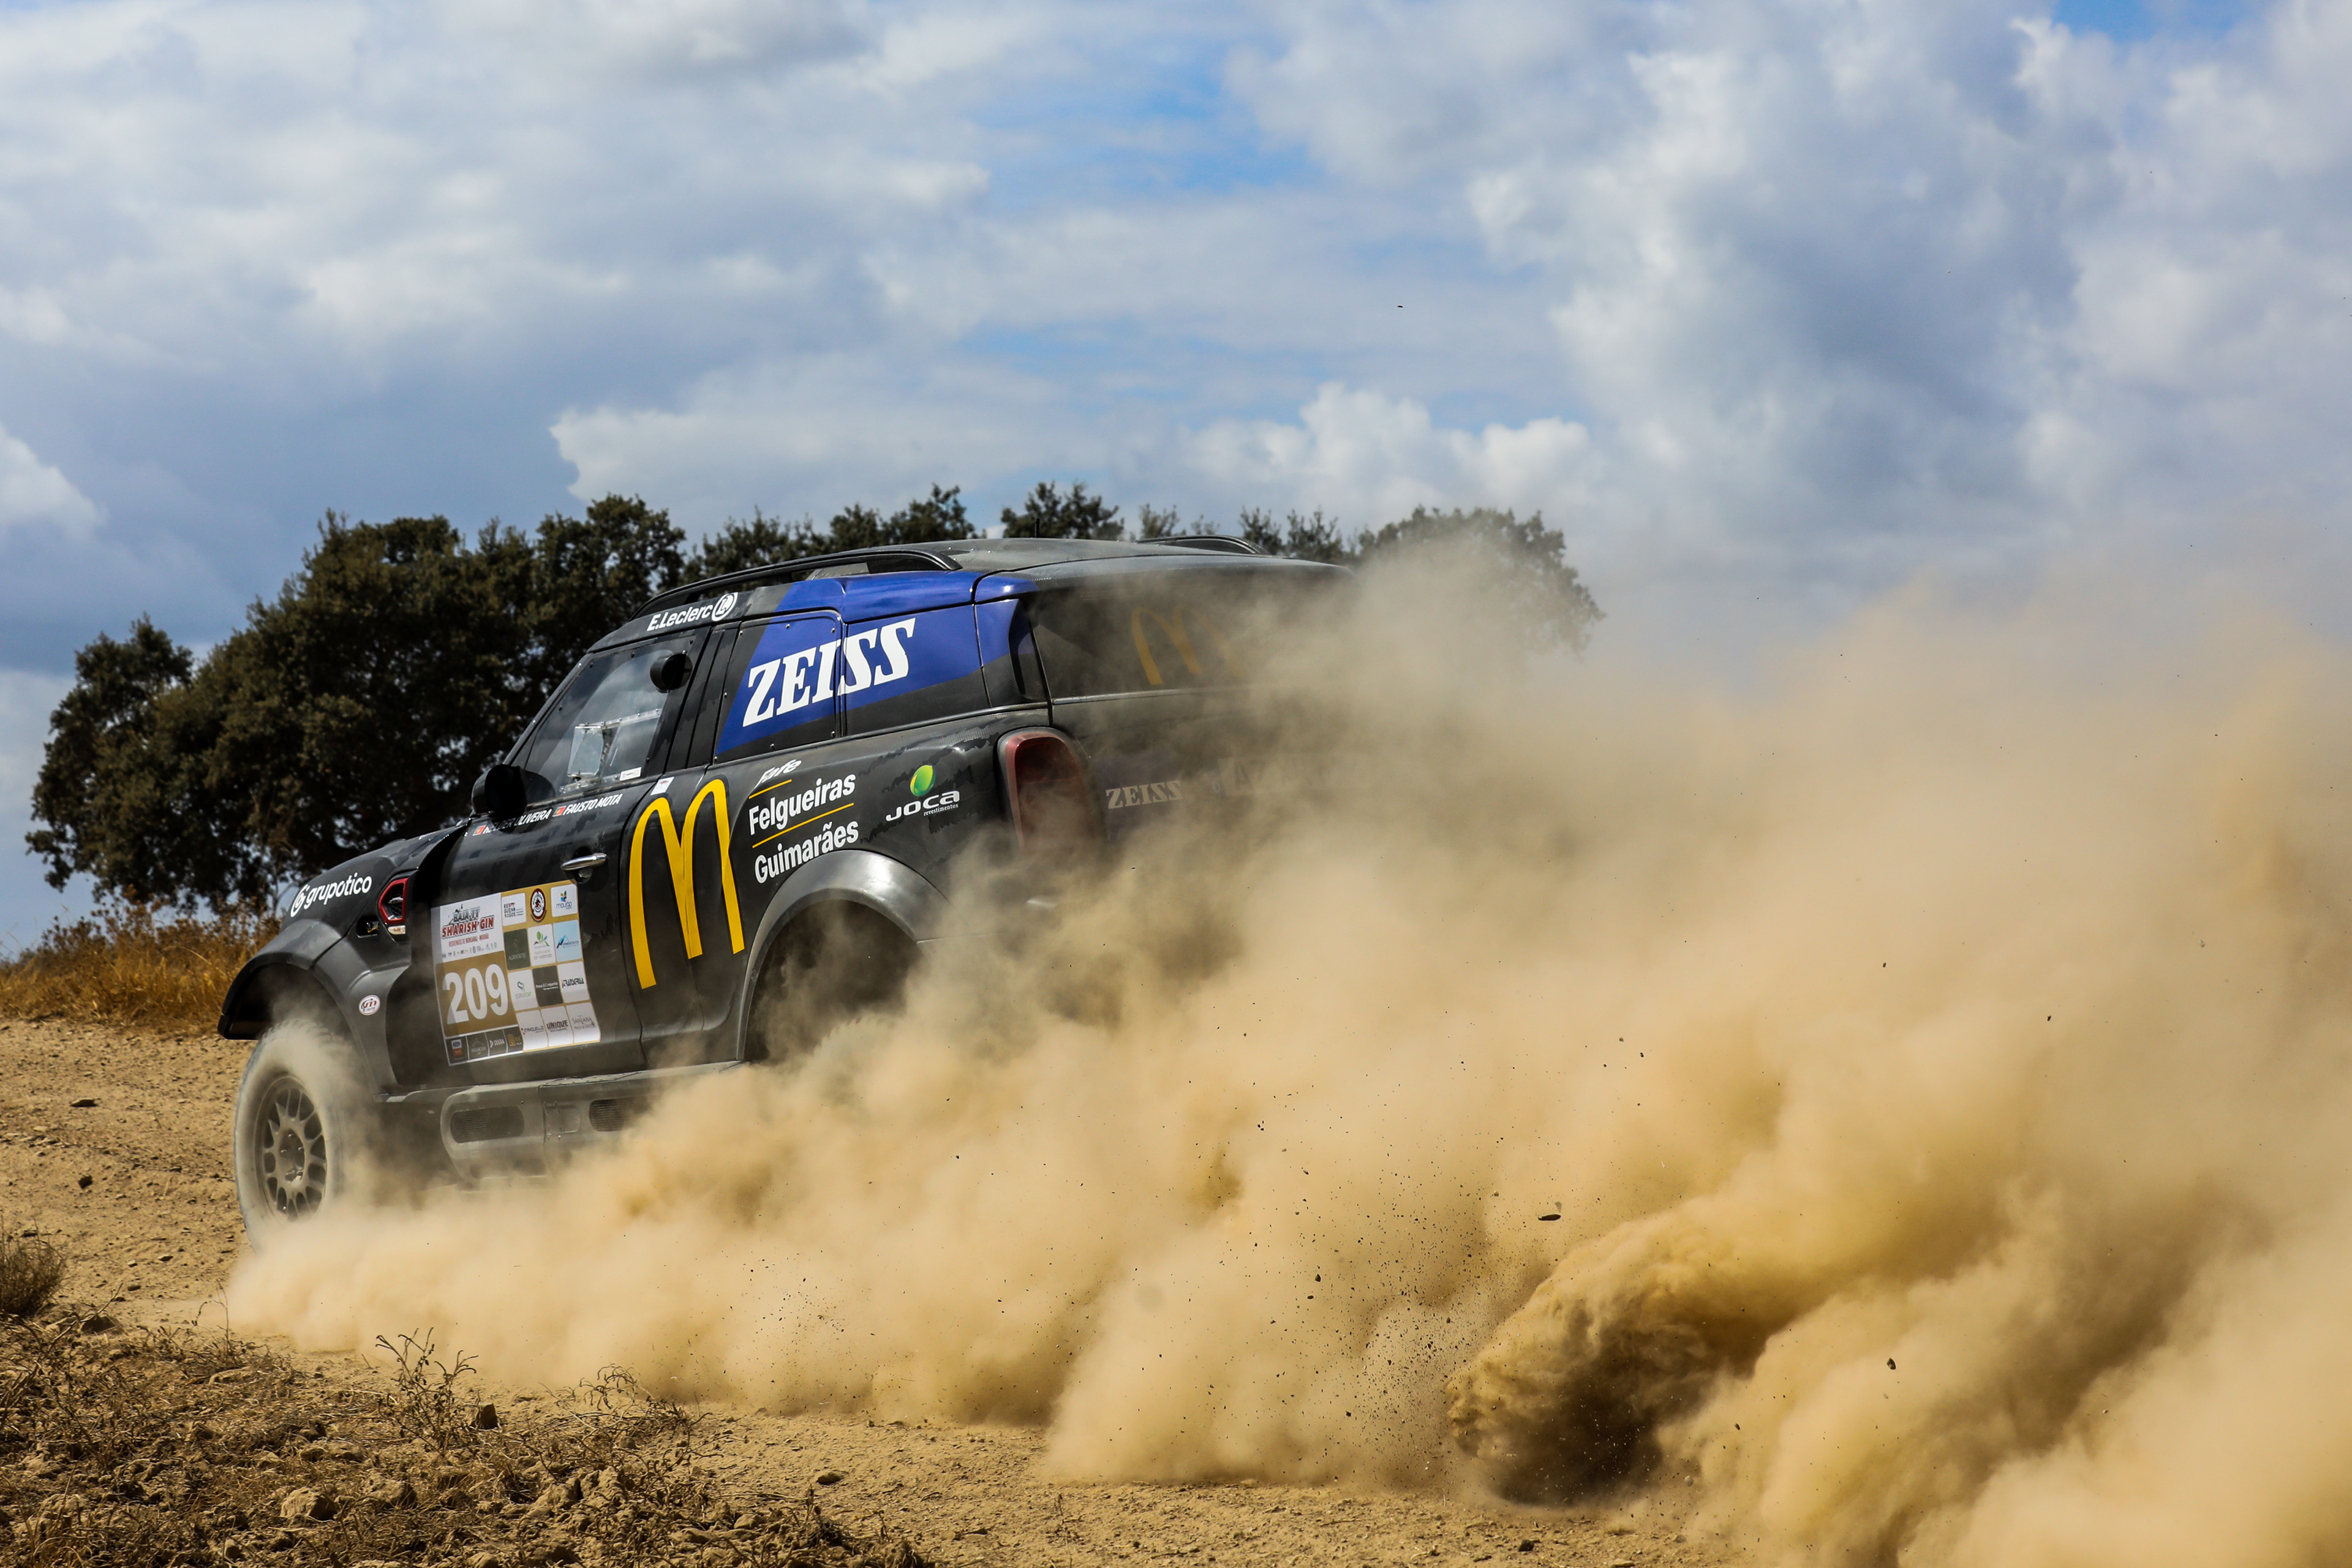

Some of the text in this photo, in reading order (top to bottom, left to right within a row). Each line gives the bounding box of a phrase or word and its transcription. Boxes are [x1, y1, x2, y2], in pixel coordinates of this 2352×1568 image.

[647, 605, 714, 631] E.Leclerc
[742, 618, 916, 728] ZEISS
[562, 794, 623, 815] FAUSTO MOTA
[749, 774, 856, 835] Felgueiras
[1106, 780, 1183, 809] ZEISS
[514, 809, 552, 826] OLIVEIRA
[924, 804, 959, 816] revestimentos
[755, 821, 859, 883] Guimarães
[303, 872, 372, 910] grupotico
[442, 916, 494, 938] SHARISH GIN
[442, 963, 509, 1025] 209
[546, 1020, 568, 1029] UNIQUE
